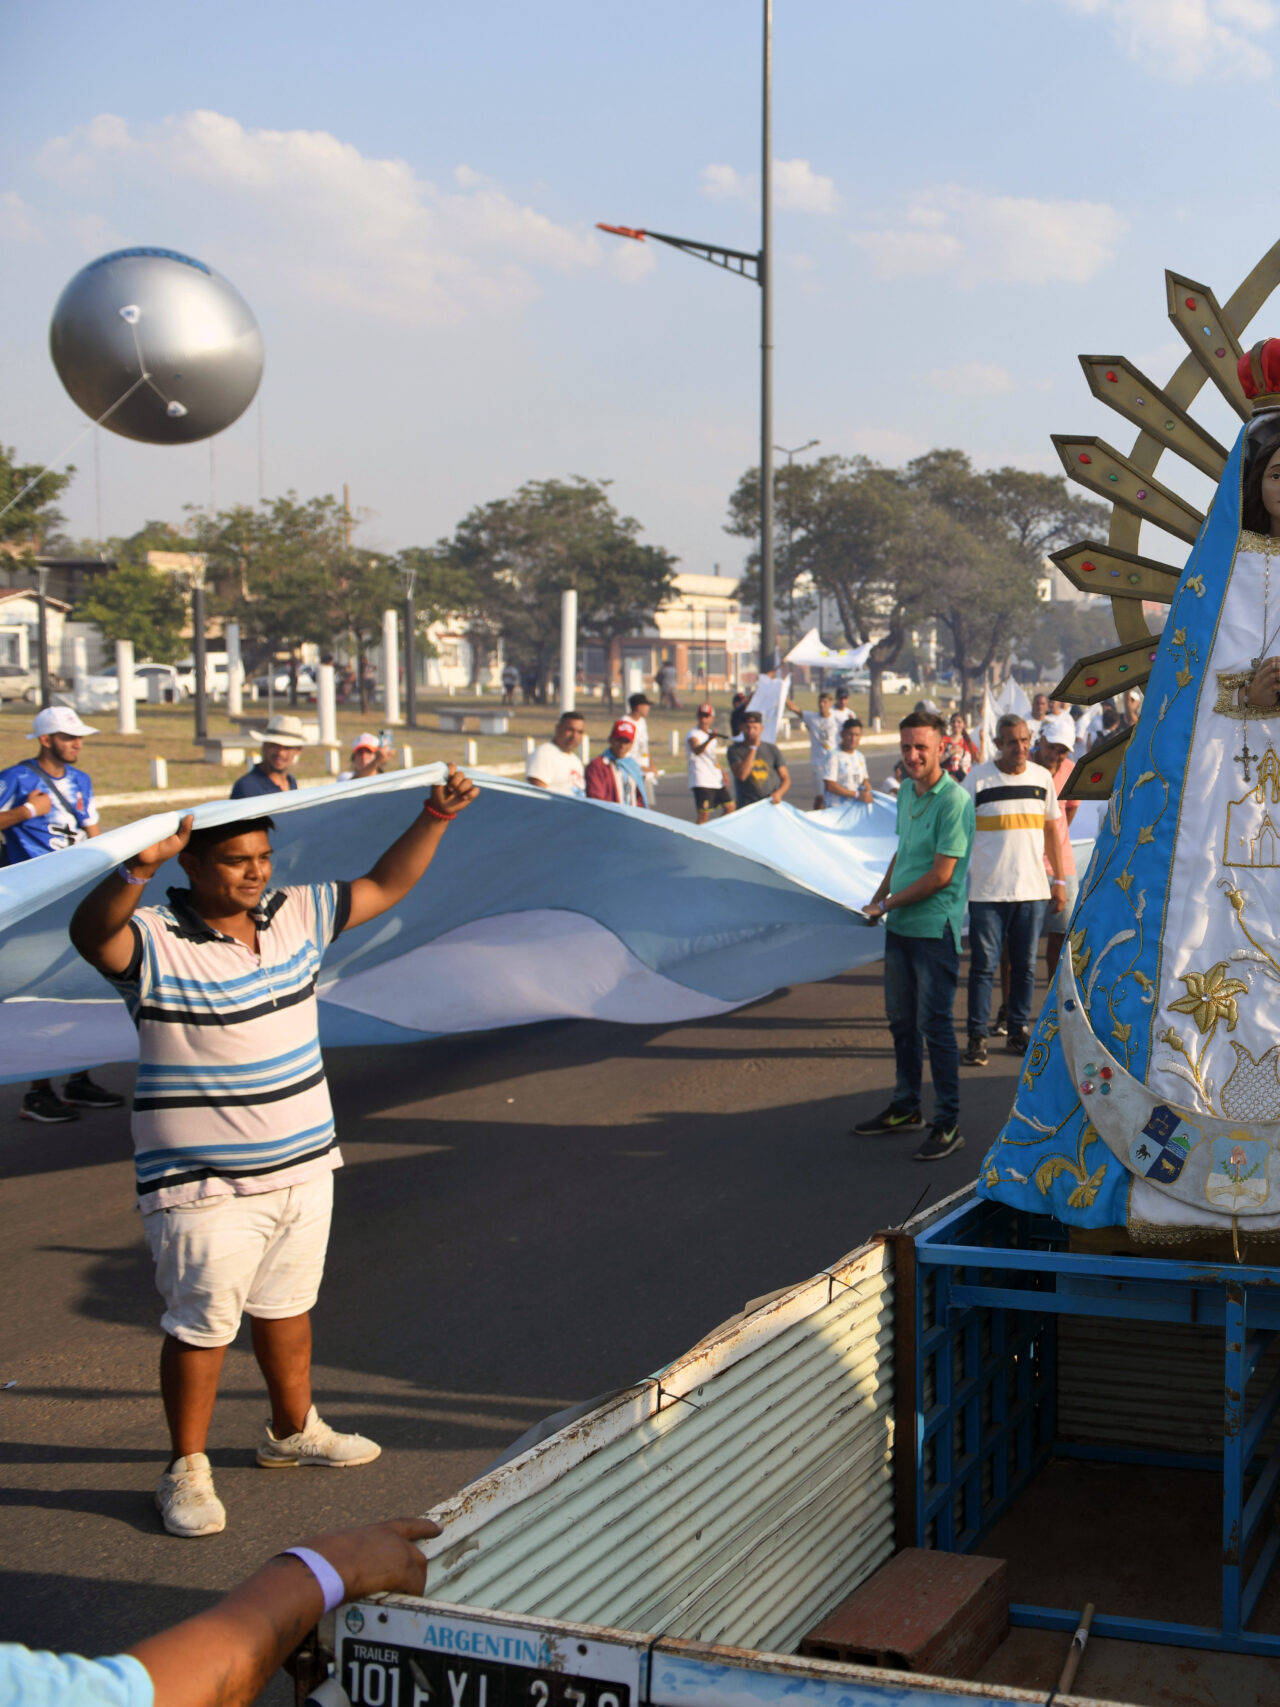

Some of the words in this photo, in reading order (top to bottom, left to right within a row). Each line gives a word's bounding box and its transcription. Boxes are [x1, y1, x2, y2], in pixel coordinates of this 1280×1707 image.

[352, 1645, 399, 1663] TRAILER
[423, 1624, 552, 1664] ARGENTINA
[348, 1660, 400, 1707] 101
